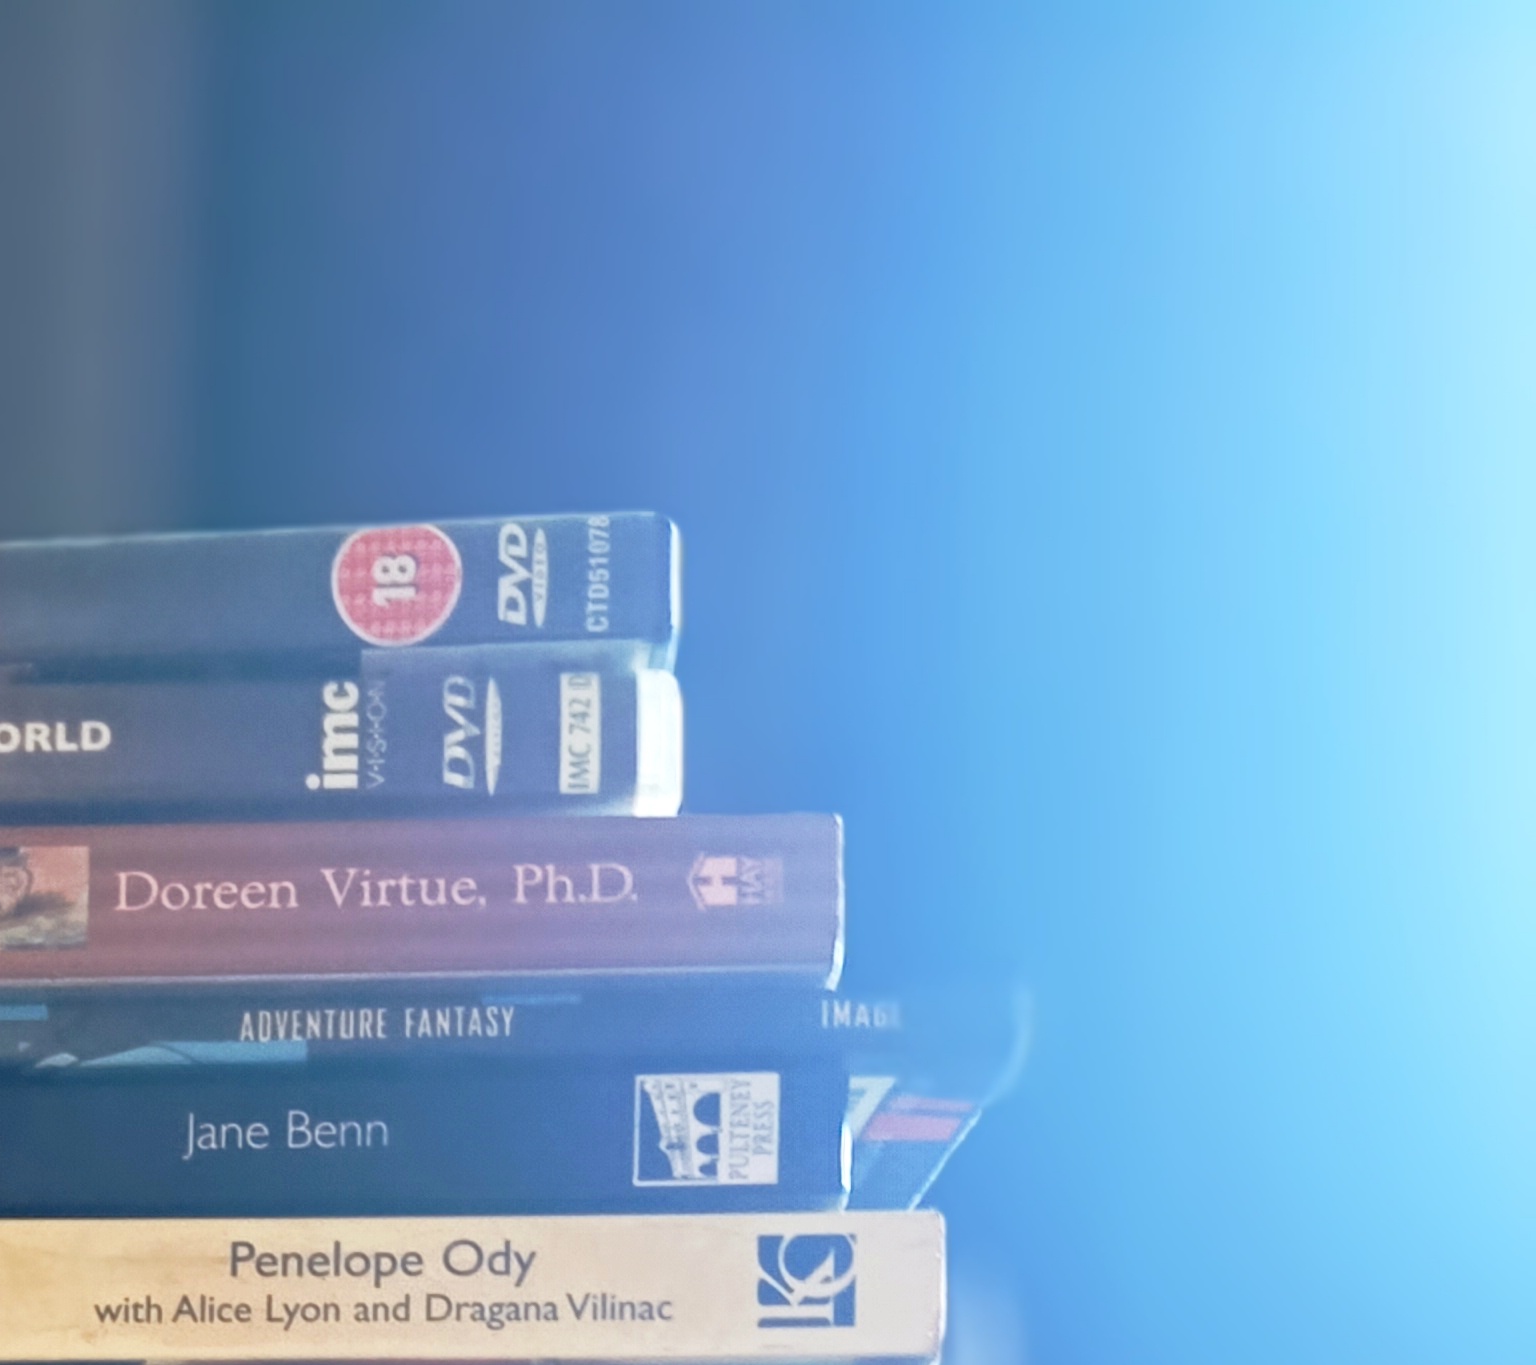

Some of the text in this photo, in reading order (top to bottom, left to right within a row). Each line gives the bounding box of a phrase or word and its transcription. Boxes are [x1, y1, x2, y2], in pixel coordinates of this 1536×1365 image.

[372, 553, 418, 610] 18
[497, 522, 532, 626] DVD
[305, 680, 360, 791] imc
[443, 675, 481, 790] DVD
[567, 694, 592, 736] 742
[567, 742, 592, 790] IMC
[115, 865, 299, 913] Doreen
[240, 1004, 516, 1042] ADVENTURE FANTASY
[183, 1111, 389, 1160] Jane Benn
[752, 1099, 776, 1156] PRESS
[229, 1238, 537, 1288] Penelope Ody
[93, 1291, 674, 1330] with Alice Lyon and Dragana Vilinac
